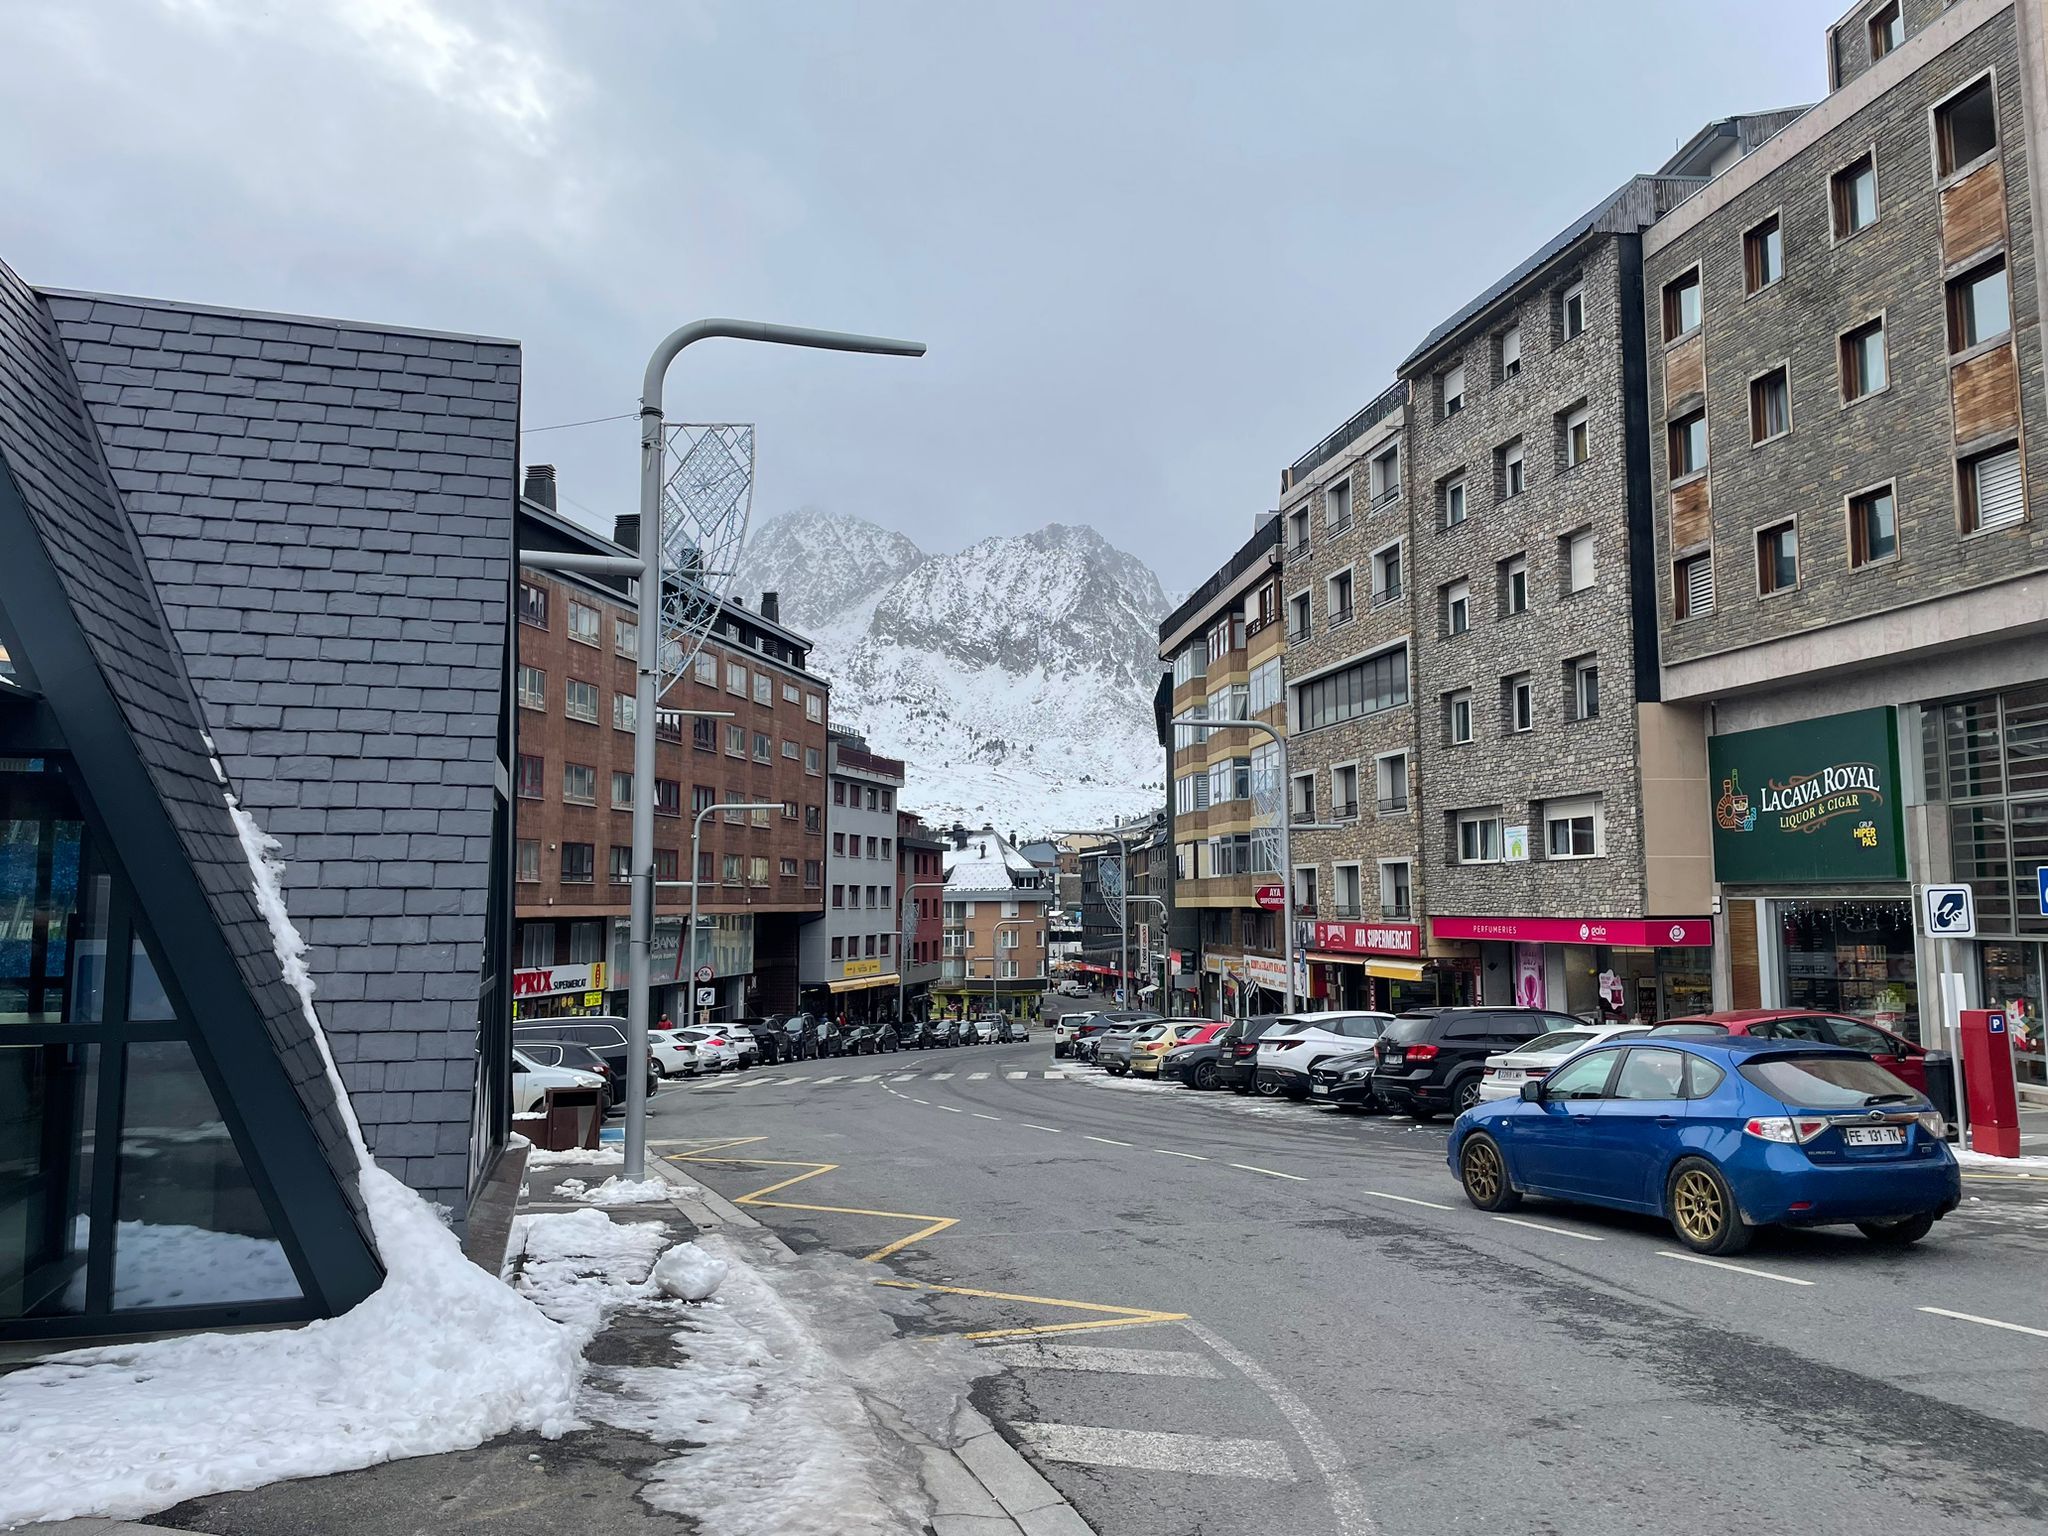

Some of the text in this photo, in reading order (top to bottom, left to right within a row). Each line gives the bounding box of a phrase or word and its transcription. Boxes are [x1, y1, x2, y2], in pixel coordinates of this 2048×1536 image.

[1822, 767, 1880, 795] ROYAL
[1780, 794, 1859, 828] LIQUOR & CIGAR
[1853, 827, 1876, 839] HIPER
[1862, 838, 1877, 847] PAS
[1269, 888, 1281, 897] AYA
[1472, 925, 1517, 934] PERFUMERIES
[1355, 929, 1367, 947] AYA
[1367, 929, 1412, 950] SUPERMERCAT
[553, 978, 587, 990] SUPERMERCAT
[1993, 1019, 2000, 1029] P
